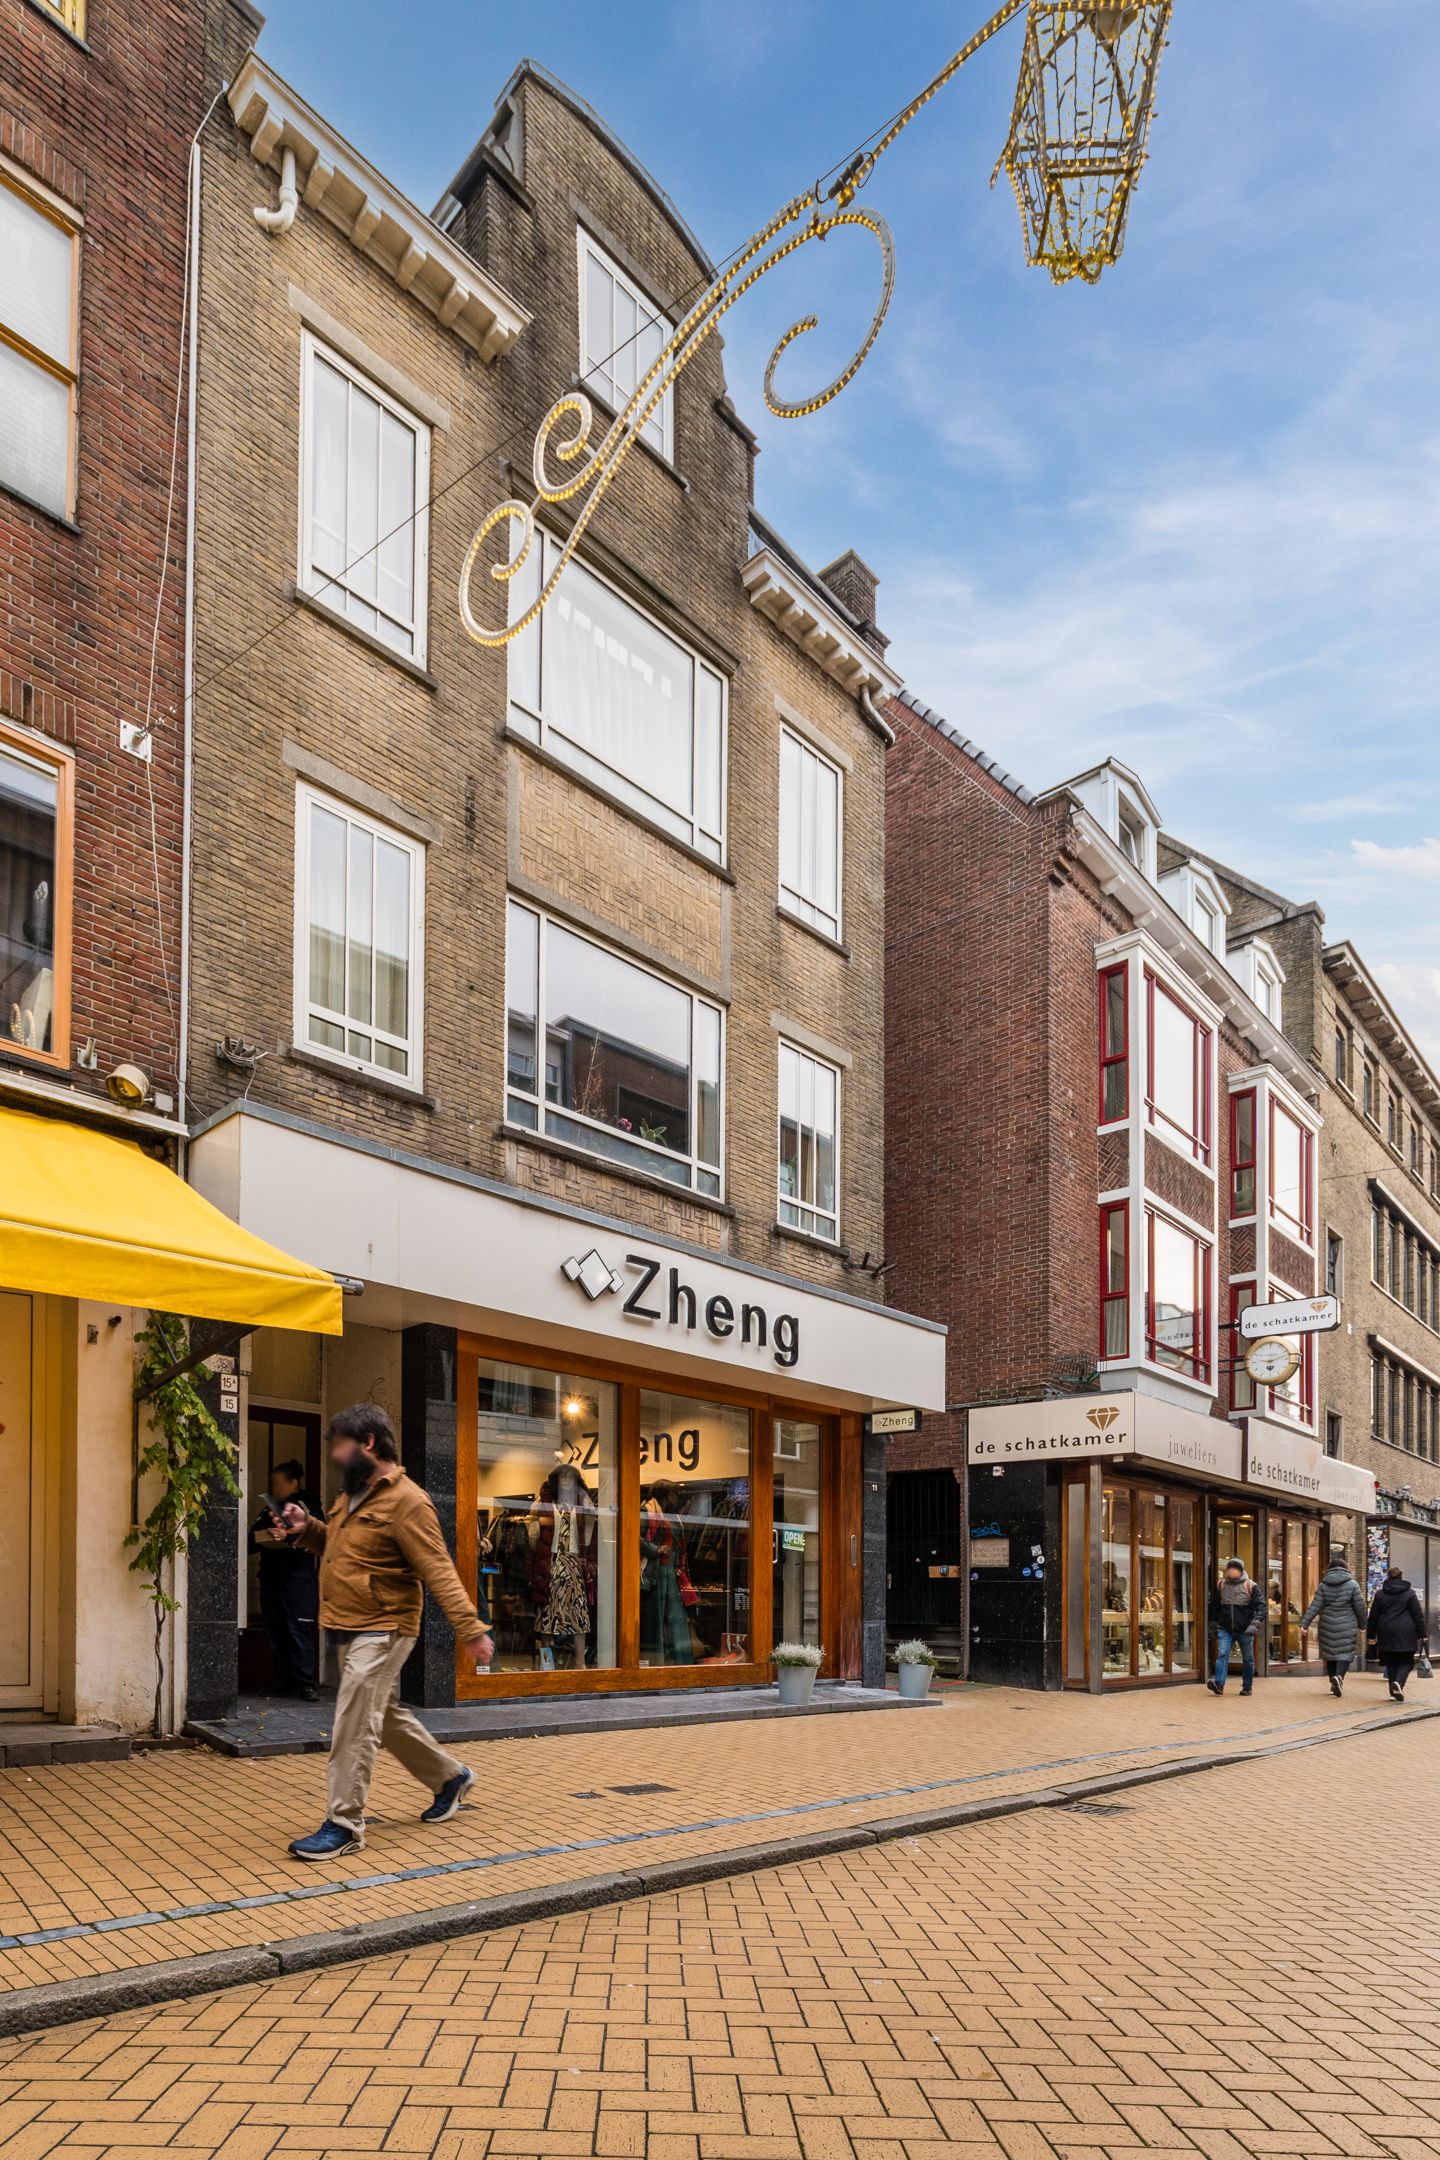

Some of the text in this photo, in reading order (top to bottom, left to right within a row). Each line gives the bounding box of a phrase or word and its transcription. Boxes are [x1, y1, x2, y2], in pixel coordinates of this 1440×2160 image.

[622, 1254, 799, 1367] Zheng
[1263, 1312, 1333, 1326] schatkamer
[224, 1399, 234, 1409] 15
[882, 1416, 914, 1427] Zheng
[581, 1430, 700, 1472] Zeng
[975, 1432, 1127, 1454] de schatkamer
[1168, 1435, 1217, 1465] juweliers
[1251, 1456, 1321, 1491] de schatkamer
[872, 1484, 878, 1492] 11
[784, 1530, 804, 1545] OPEN
